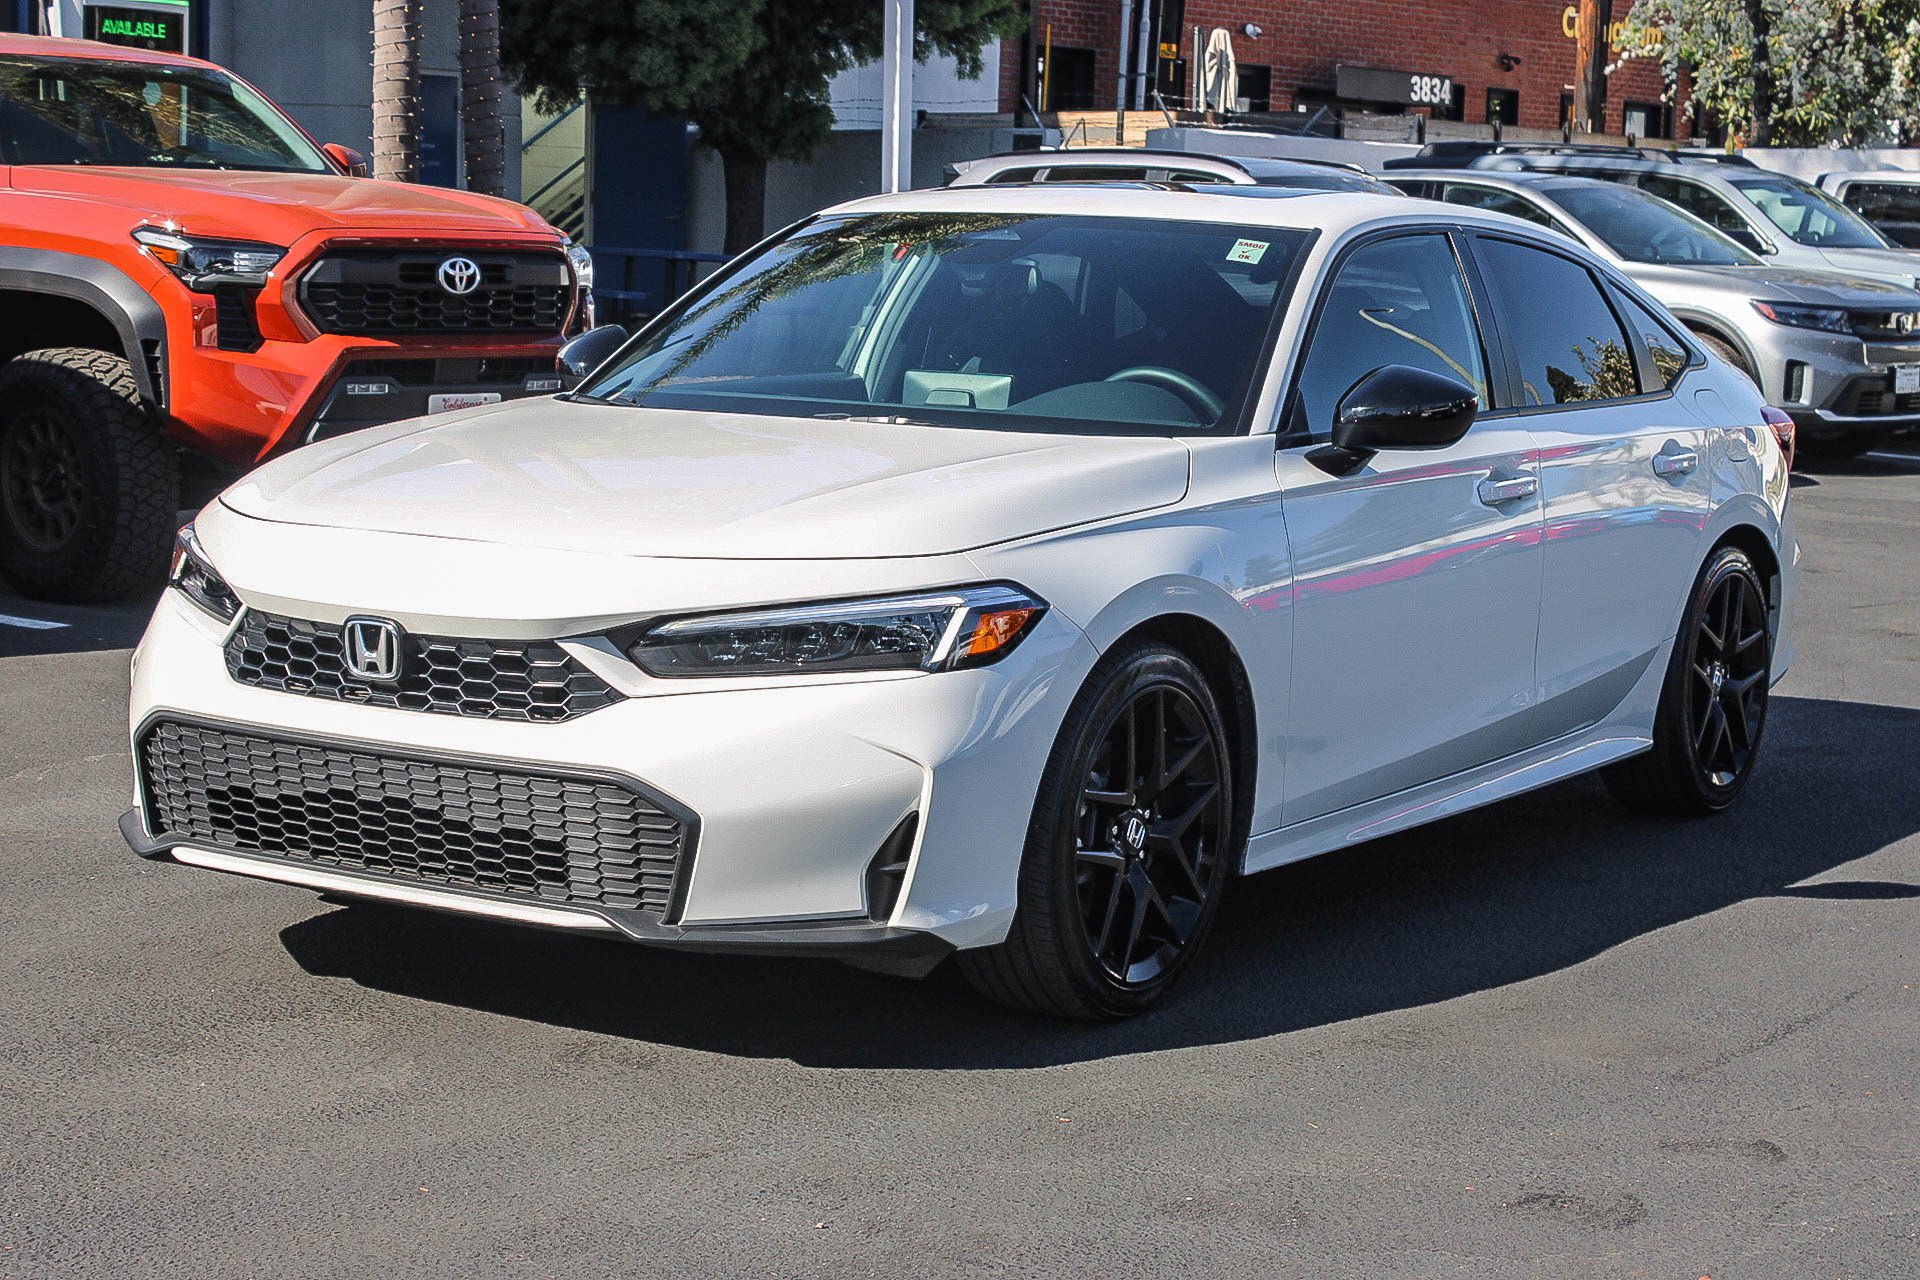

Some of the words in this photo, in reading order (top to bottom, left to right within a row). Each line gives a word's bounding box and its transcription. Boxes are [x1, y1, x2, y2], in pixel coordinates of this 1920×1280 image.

[102, 18, 166, 38] AVAILABLE
[1410, 75, 1451, 104] 3834
[1237, 241, 1266, 249] SMOG
